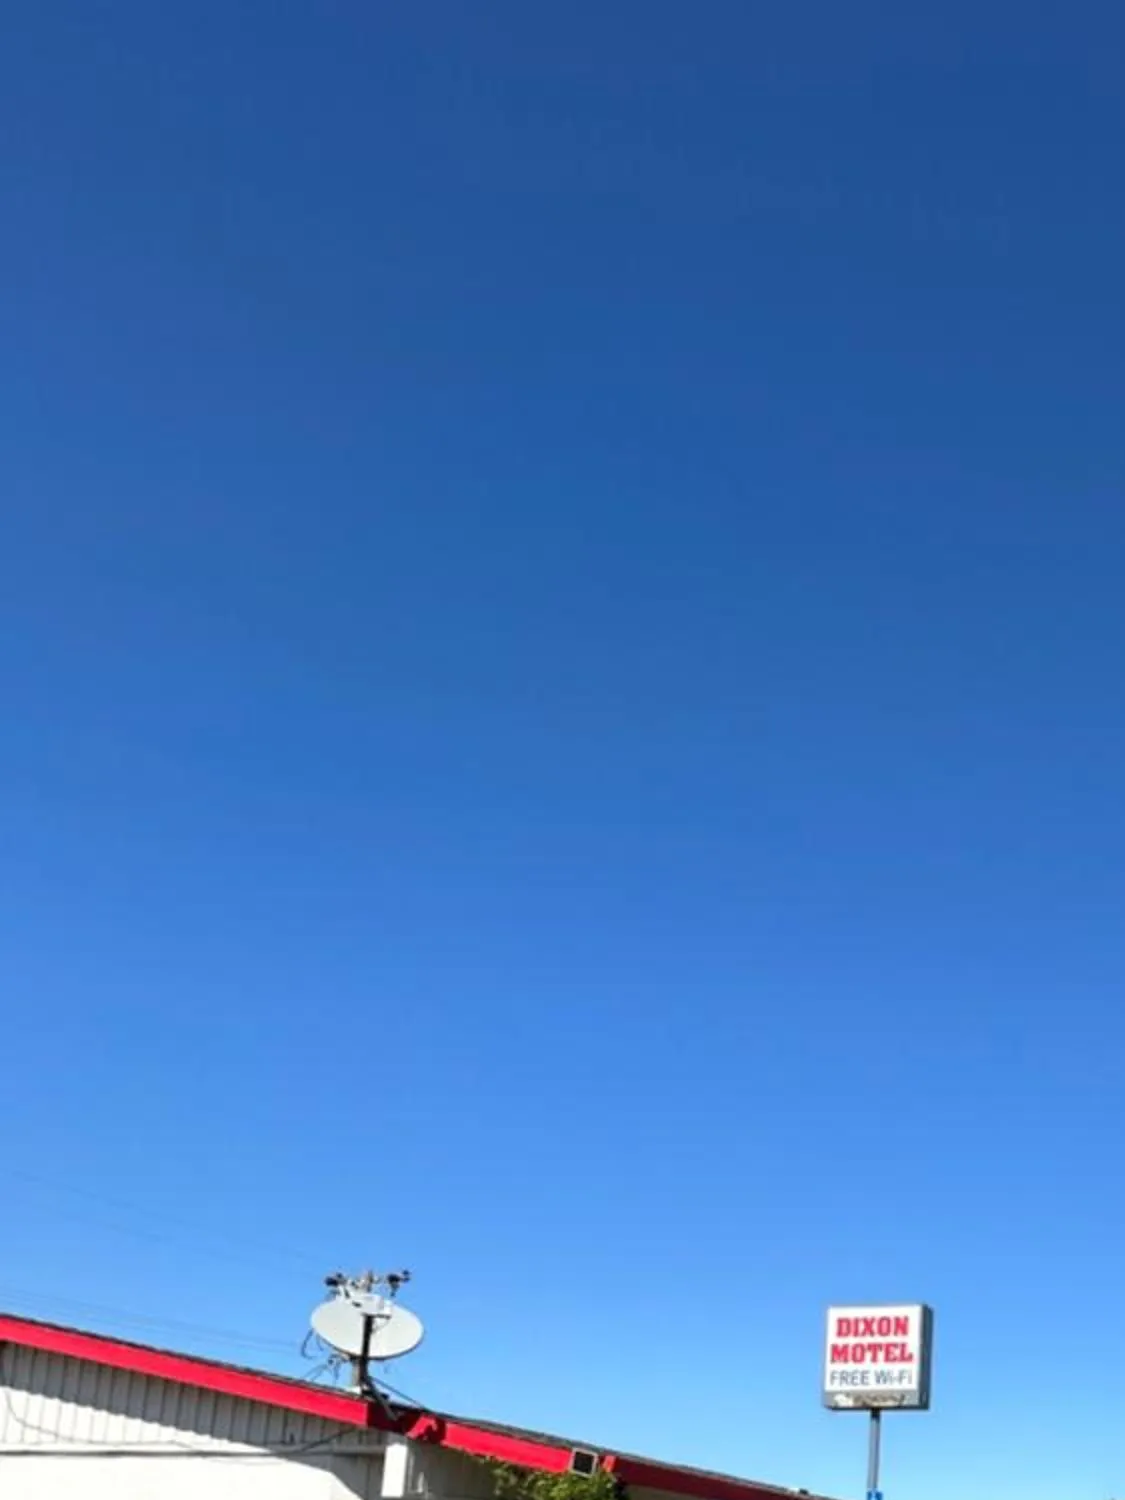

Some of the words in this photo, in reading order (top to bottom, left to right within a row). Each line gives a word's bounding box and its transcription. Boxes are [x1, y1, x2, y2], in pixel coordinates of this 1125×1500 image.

[837, 1316, 909, 1337] DIXON
[830, 1342, 914, 1364] MOTEL
[830, 1369, 870, 1386] FREE
